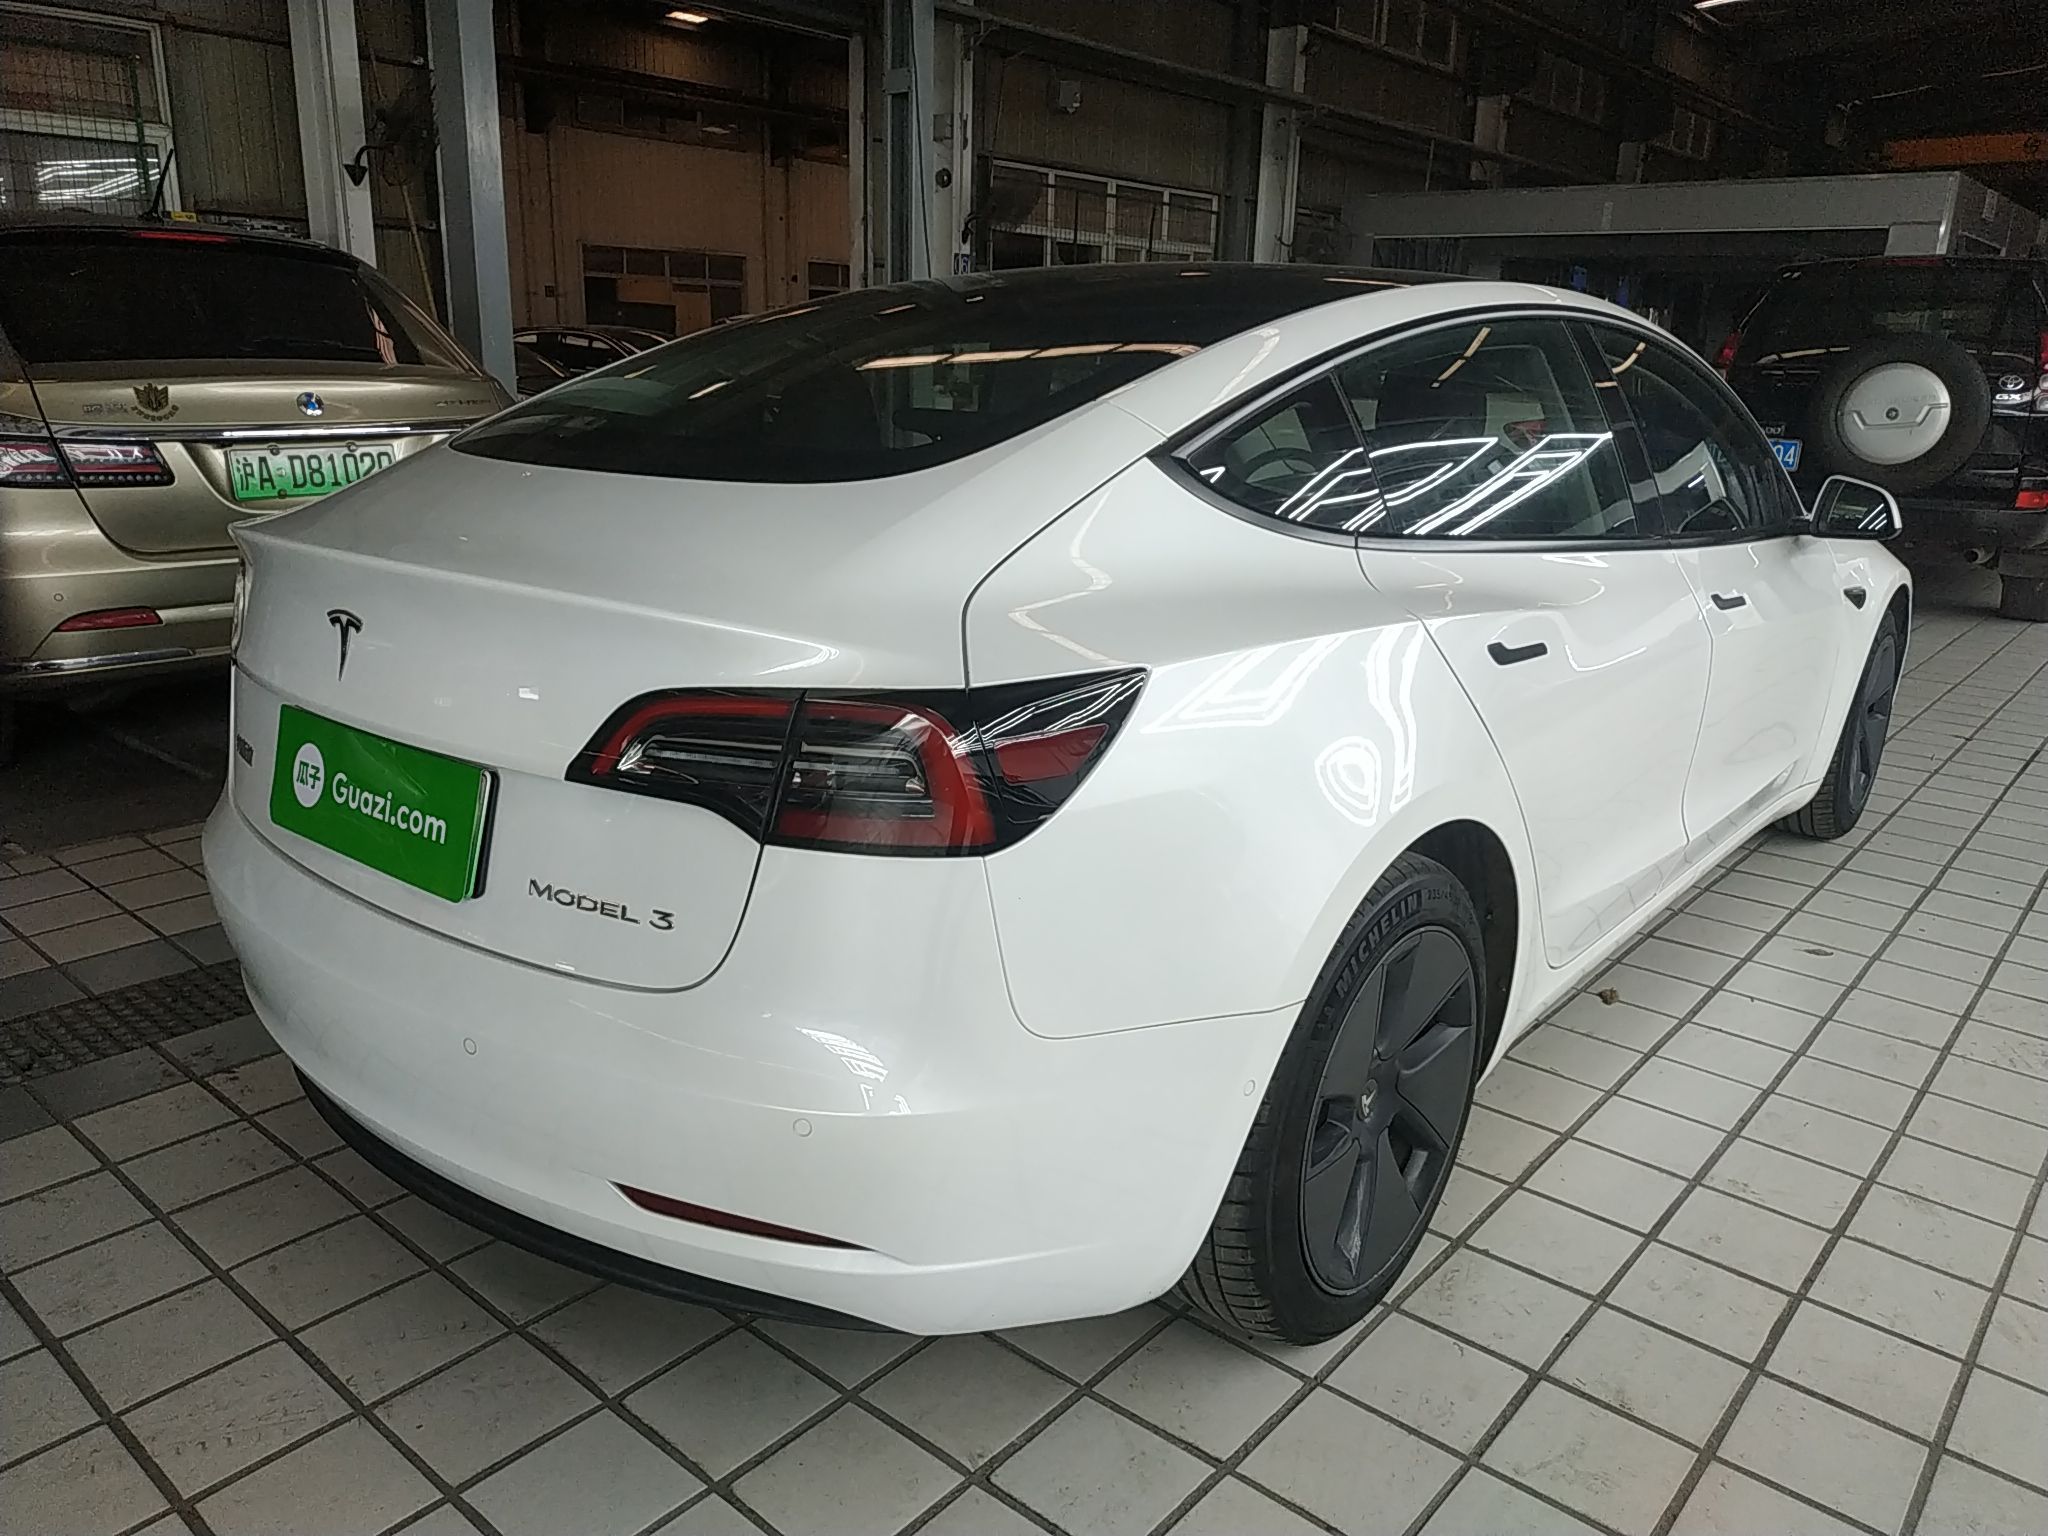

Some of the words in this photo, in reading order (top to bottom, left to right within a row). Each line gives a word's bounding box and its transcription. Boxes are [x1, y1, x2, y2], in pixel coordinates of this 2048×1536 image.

[296, 759, 322, 790] 瓜子
[332, 772, 447, 845] Guazi.com
[528, 878, 641, 925] MODEL
[648, 909, 675, 931] 3
[1334, 892, 1421, 999] MICHELIN
